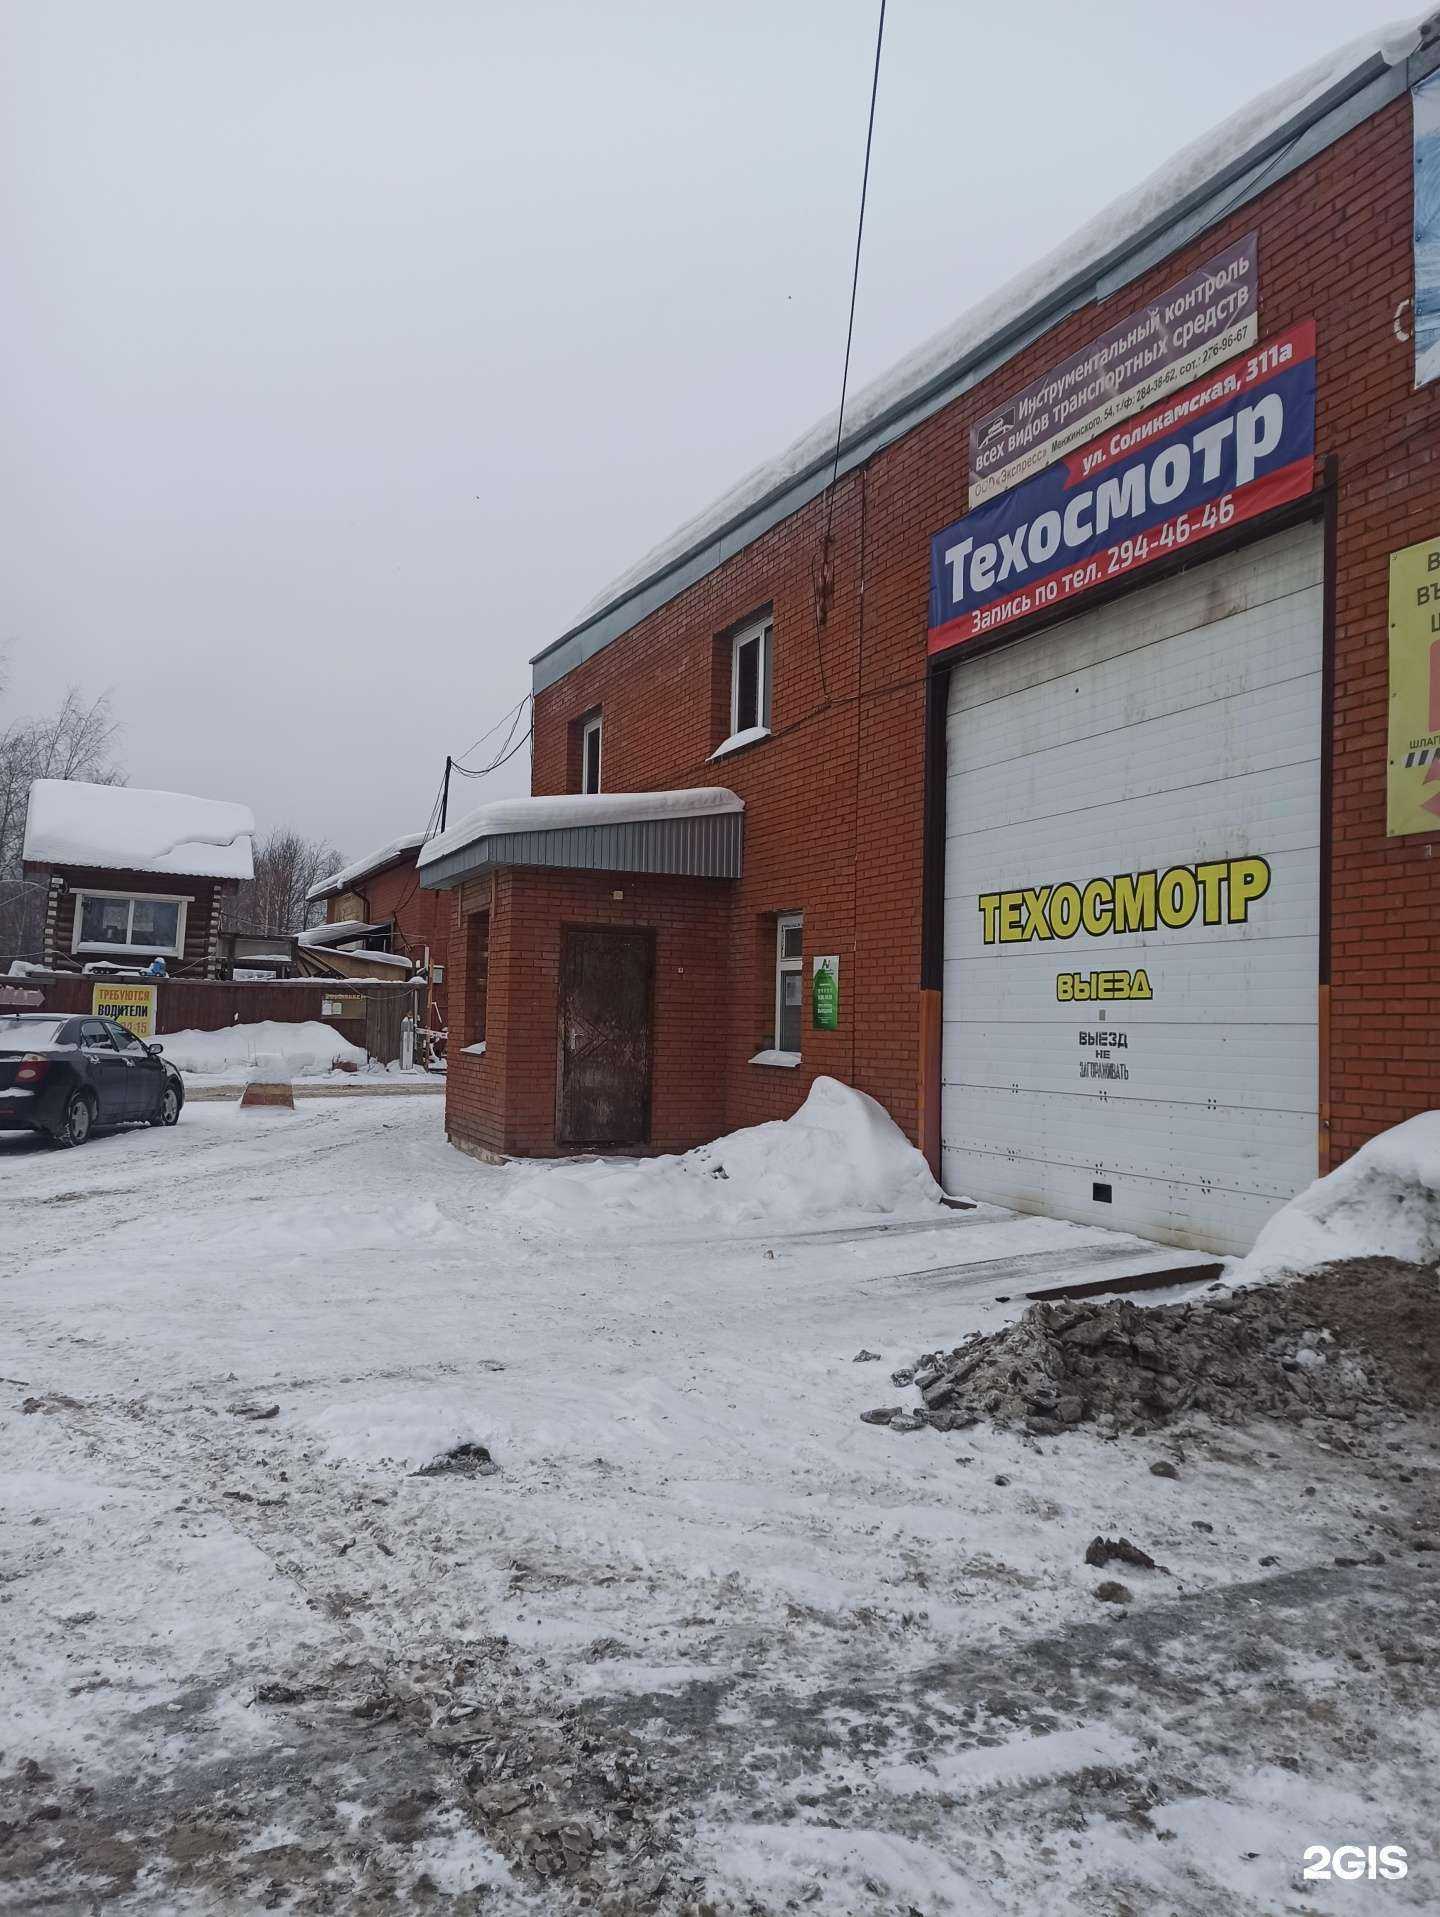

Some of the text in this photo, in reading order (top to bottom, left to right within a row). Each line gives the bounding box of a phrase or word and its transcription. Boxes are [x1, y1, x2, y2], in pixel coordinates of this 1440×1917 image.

[1018, 256, 1250, 420] Инструментальный контроль
[1202, 325, 1248, 364] 276-96-67
[975, 285, 1249, 472] всех видов транспортных средств
[1082, 342, 1294, 476] ул. Соликамская, 311а
[945, 392, 1284, 604] Техосмотр
[971, 494, 1235, 633] Запись по тел. 294-46-46
[978, 855, 1271, 945] ТЕХОСМОТР
[97, 1004, 148, 1018] ВОДИТЕЛИ
[99, 989, 150, 1001] ТРЕБУЮТСЯ
[1056, 968, 1153, 1002] ВЫЕЗД
[1079, 1031, 1128, 1049] ВЫЕЗД
[1095, 1049, 1112, 1060] НЕ
